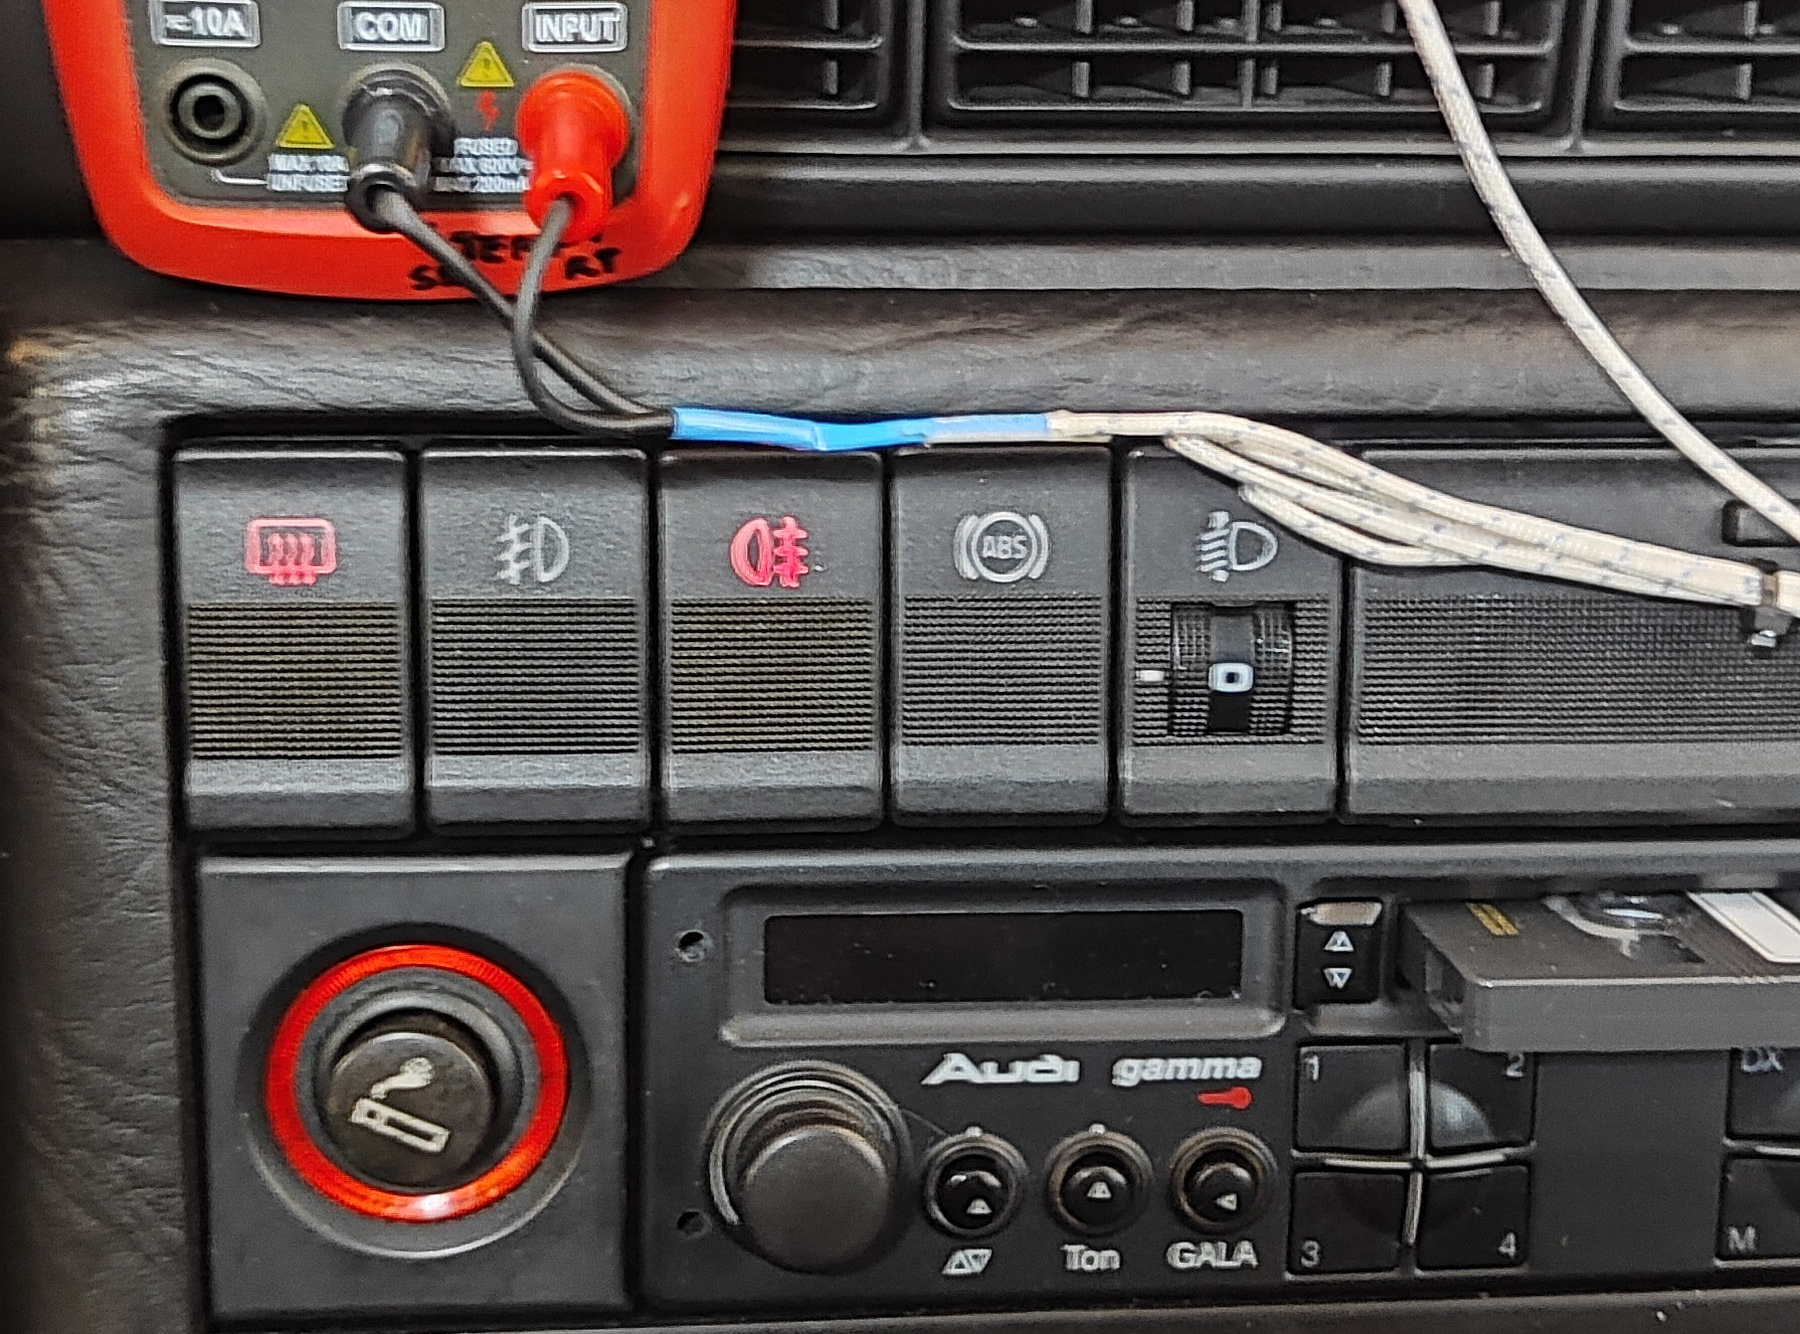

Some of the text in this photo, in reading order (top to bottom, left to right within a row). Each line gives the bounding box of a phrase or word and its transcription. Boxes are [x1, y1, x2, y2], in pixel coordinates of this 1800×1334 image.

[354, 12, 427, 41] COM
[534, 12, 621, 43] INPUT
[982, 536, 1027, 559] ABS
[921, 1052, 1263, 1087] Audi gamma
[1305, 1055, 1320, 1081] 1
[1505, 1053, 1525, 1077] 2
[1300, 1240, 1321, 1266] 3
[1498, 1231, 1517, 1256] 4
[1728, 1227, 1756, 1253] M
[1063, 1245, 1121, 1273] Ton
[1167, 1241, 1258, 1269] GALA
